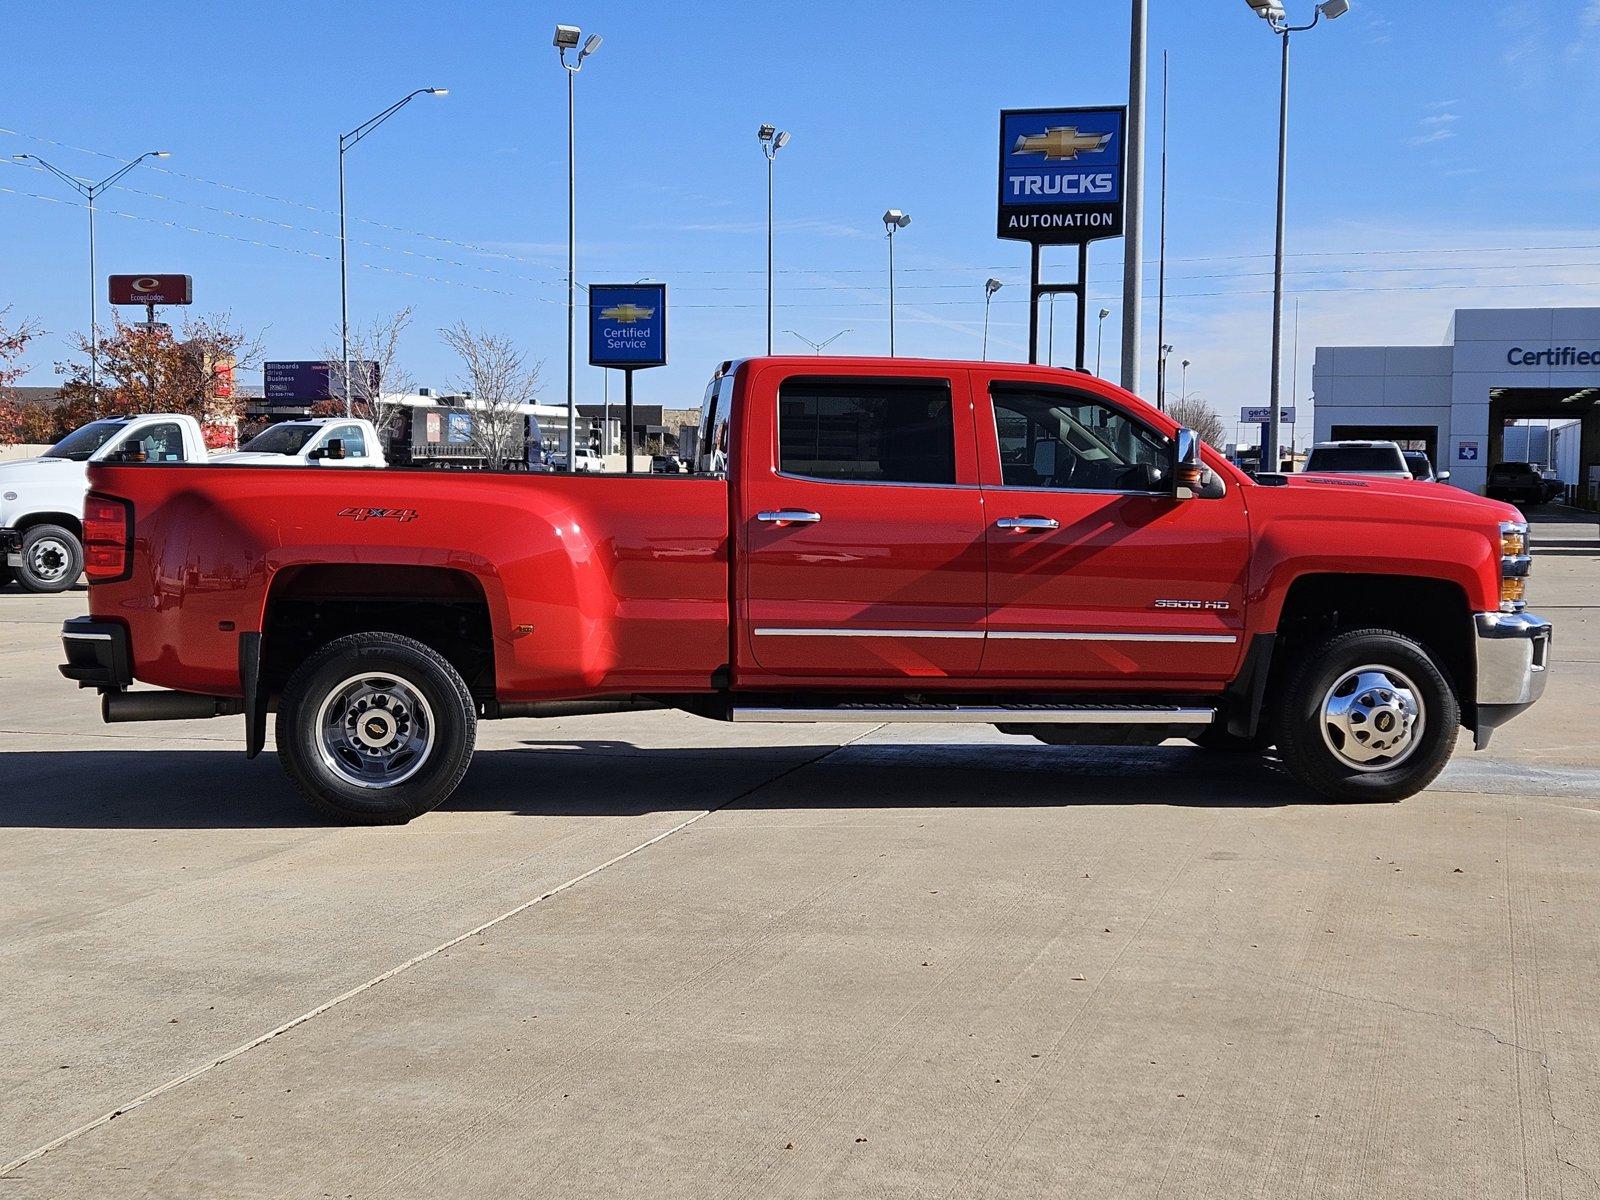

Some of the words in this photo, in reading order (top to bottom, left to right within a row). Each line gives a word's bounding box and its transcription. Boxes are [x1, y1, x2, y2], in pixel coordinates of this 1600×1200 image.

[1009, 173, 1113, 195] TRUCKS
[1008, 212, 1113, 228] AUTONATION
[603, 327, 651, 338] Certified
[607, 338, 647, 349] Service
[337, 507, 418, 522] 4x4
[1154, 599, 1202, 609] 3500
[1204, 601, 1230, 610] HD
